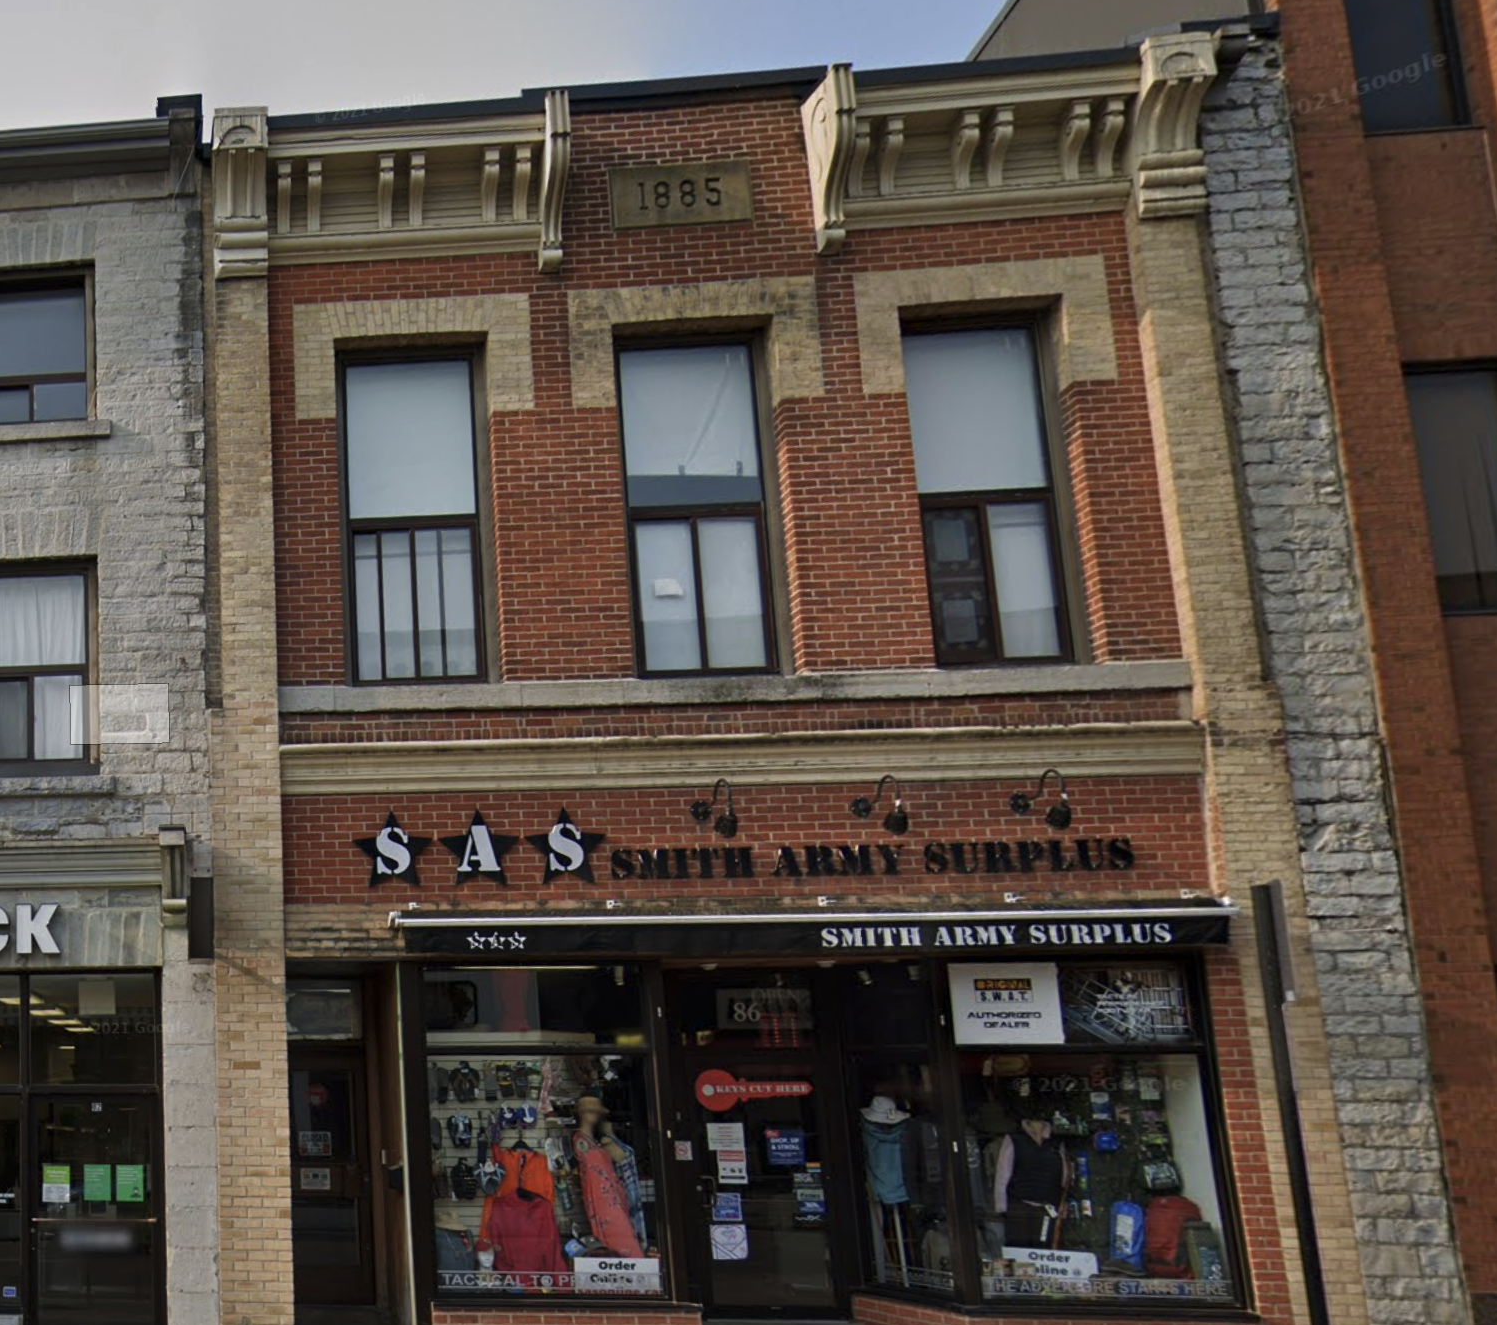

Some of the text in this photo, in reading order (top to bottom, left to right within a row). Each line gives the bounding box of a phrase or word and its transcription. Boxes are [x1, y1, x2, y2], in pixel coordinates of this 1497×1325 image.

[637, 177, 722, 211] 1885
[610, 837, 1136, 880] SMITH ARMY SURPLUS
[821, 922, 1173, 948] SMITH ARMY SURPLUS
[732, 1002, 761, 1022] 86
[967, 1011, 1042, 1020] AUTHORIZED
[983, 1021, 1030, 1029] DEALER
[715, 1084, 809, 1094] KEYS CUT HERE
[1028, 1251, 1071, 1264] Order
[598, 1260, 637, 1271] Order
[1186, 1281, 1228, 1296] HERE
